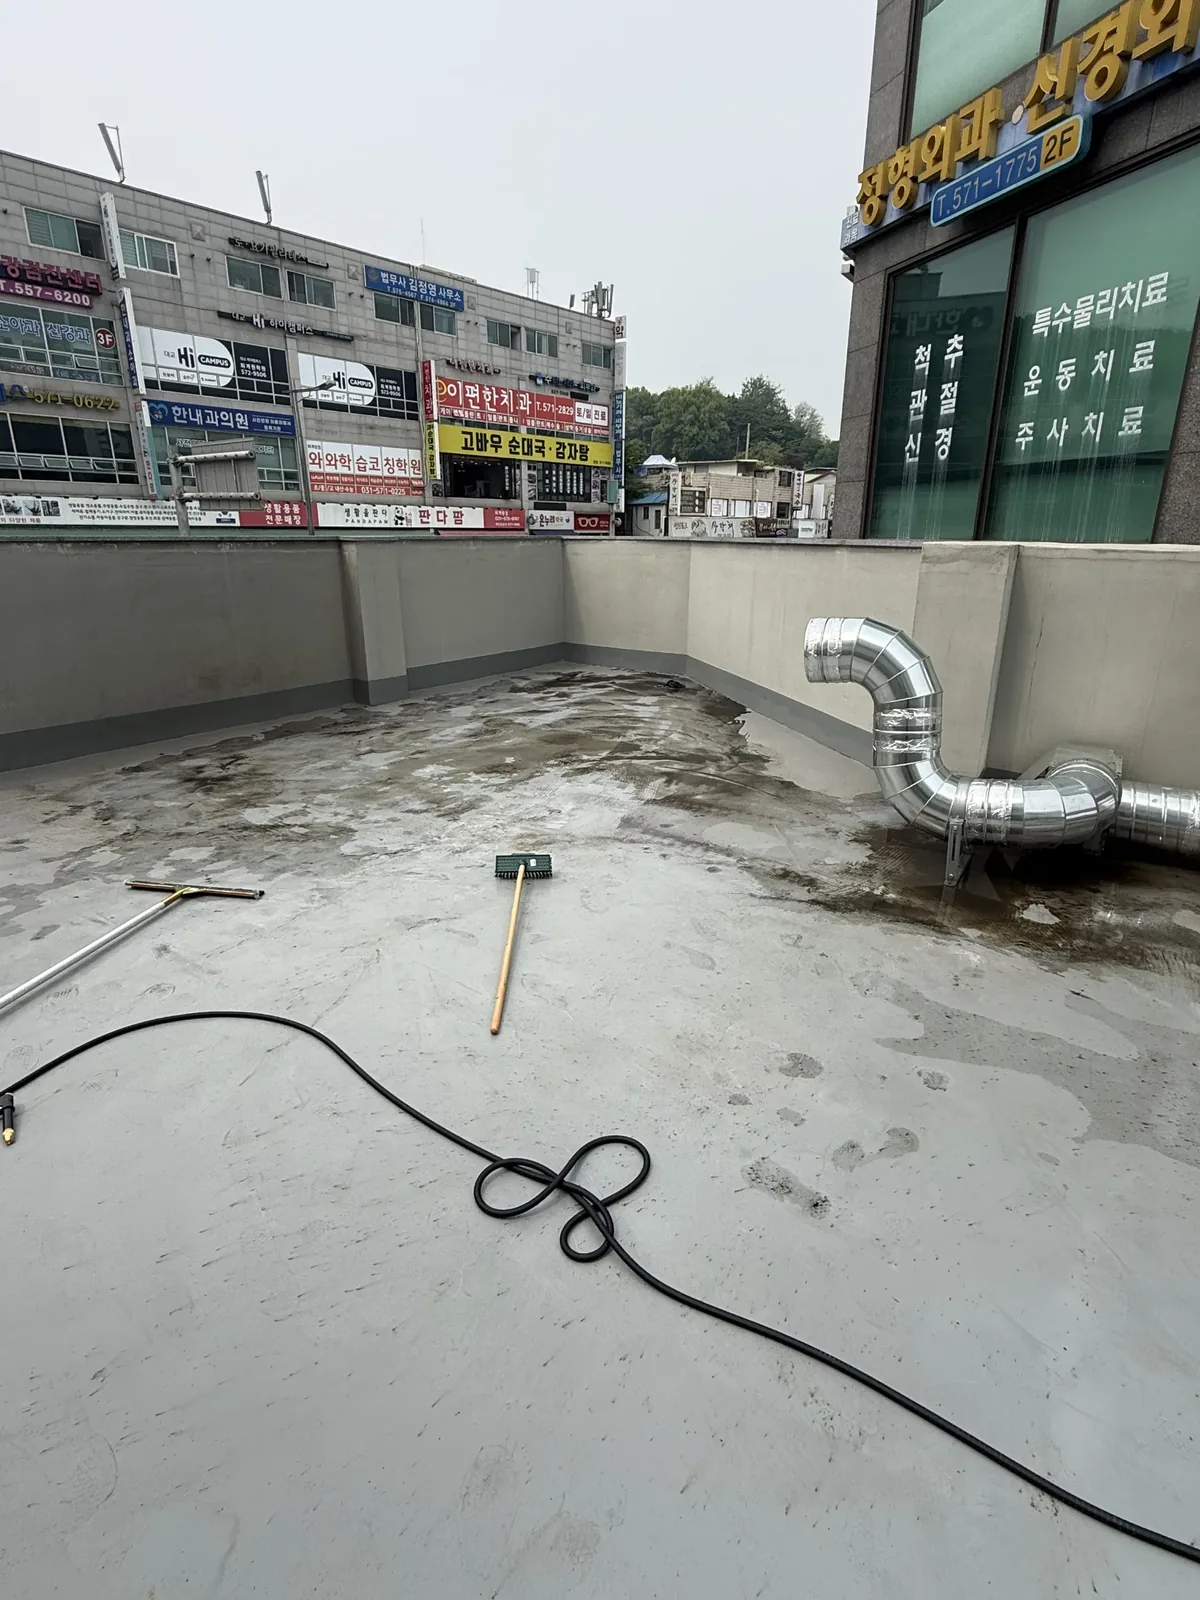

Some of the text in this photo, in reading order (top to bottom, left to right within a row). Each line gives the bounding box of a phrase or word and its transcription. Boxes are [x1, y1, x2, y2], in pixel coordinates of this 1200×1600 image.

[936, 126, 1075, 217] T.571-1775 2F
[0, 280, 91, 306] T.557-6200
[381, 271, 462, 302] 법무사 김정영 사무소
[1032, 272, 1169, 337] 특수물리치료
[252, 313, 265, 329] Hi
[269, 320, 314, 336] 하이캠퍼스
[97, 332, 113, 345] 3F
[177, 346, 195, 369] Hi
[199, 356, 229, 368] CAMPUS
[914, 333, 964, 375] 척추
[1023, 340, 1155, 397] 운동치료
[349, 378, 372, 388] CAMPUS
[446, 381, 532, 416] 이편한치과
[536, 401, 574, 416] T.571-2829
[909, 381, 958, 421] 관절
[171, 405, 249, 430] 한내과의원
[577, 407, 607, 421] 토/일 진료
[1015, 405, 1144, 450] 주사치료
[461, 430, 589, 462] 고바우 순대국·감자탕
[904, 427, 953, 463] 신경
[308, 451, 422, 476] 와와학습코칭학원
[264, 503, 300, 514] 생활용품
[265, 514, 301, 525] 전문매장
[418, 509, 464, 525] 판다팜
